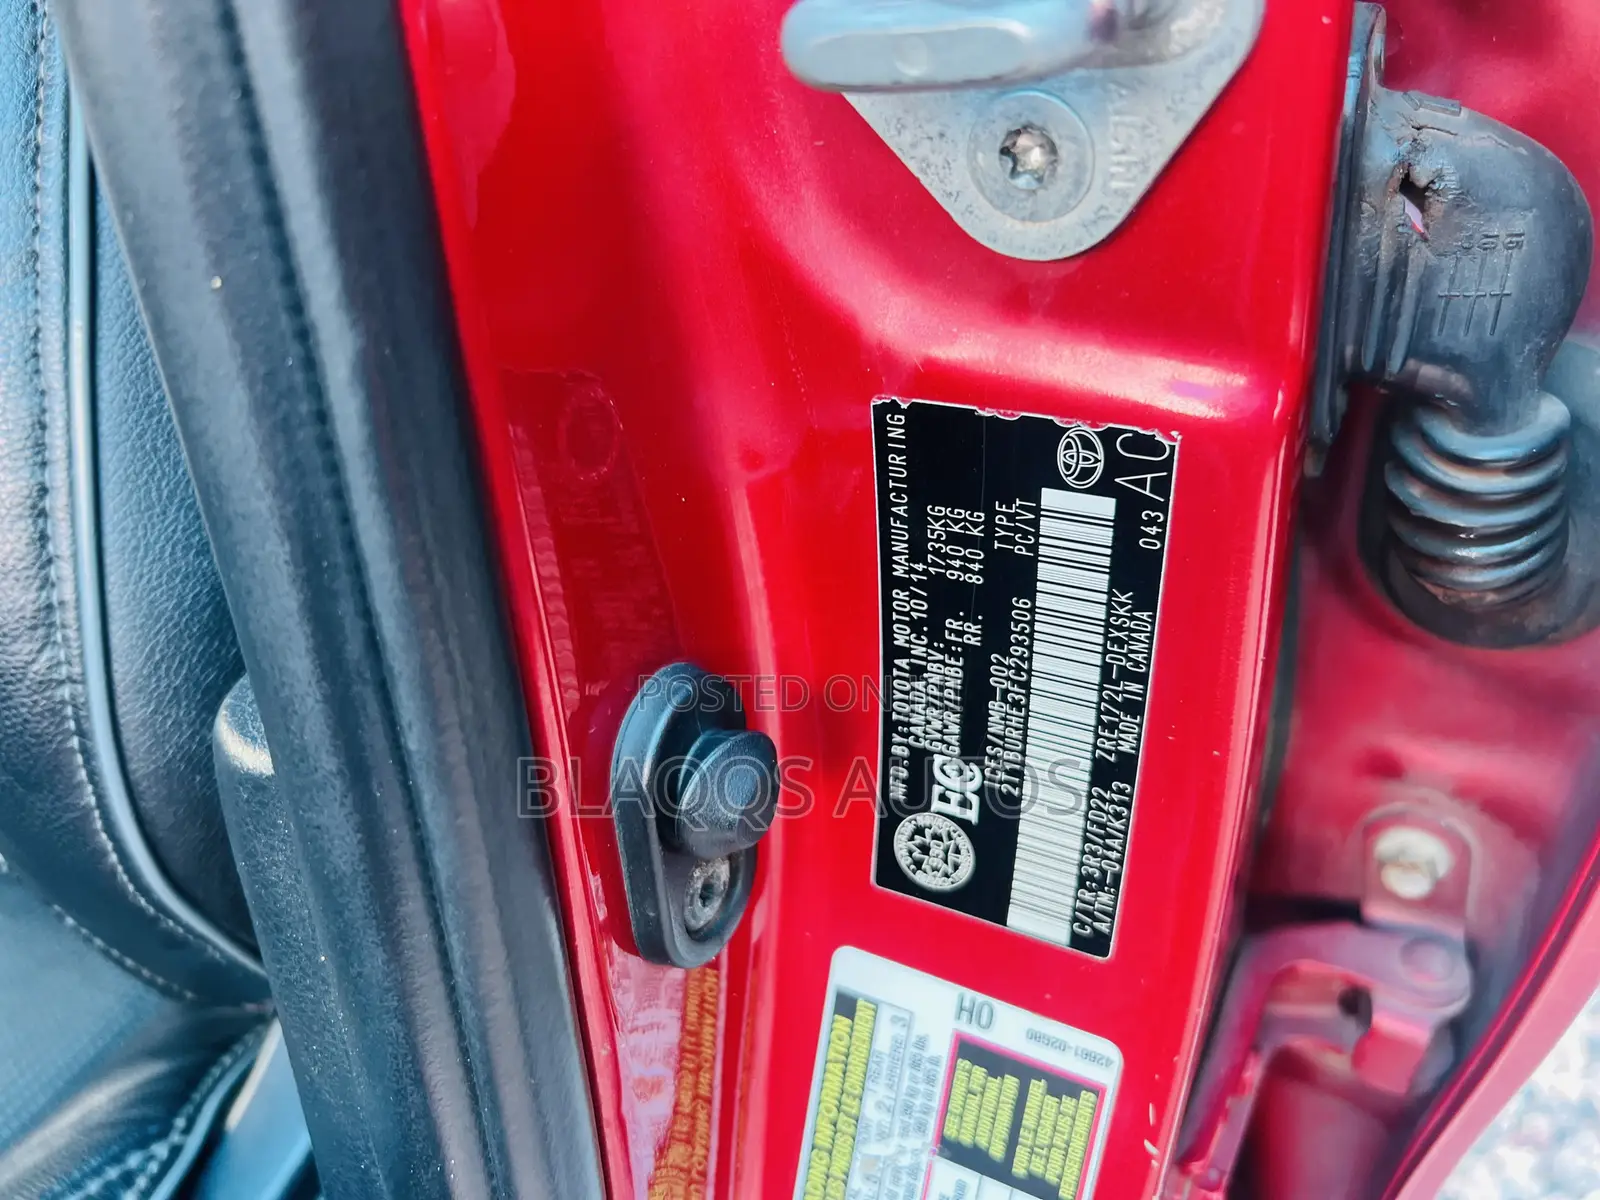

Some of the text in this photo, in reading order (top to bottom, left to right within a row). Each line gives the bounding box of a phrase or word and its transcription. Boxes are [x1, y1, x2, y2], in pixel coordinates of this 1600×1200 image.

[887, 413, 910, 578] MANUFACTURING
[946, 507, 965, 532] KG
[1114, 432, 1170, 550] 043 AC
[946, 546, 965, 581] 940
[963, 511, 985, 647] RR. 840 KG
[893, 588, 910, 647] MOTOR
[925, 505, 946, 752] GVWR/PNBV: 1735KG
[984, 501, 1015, 788] ICES/NMB-002 TYPE
[1001, 498, 1036, 797] 2T1BURHE3FC293506 PC/VT
[1096, 588, 1133, 763] ZRE172L-DEXSKK
[1117, 611, 1152, 755] MADE IN CANADA
[814, 1014, 853, 1149] INFORMATION
[843, 998, 878, 1098] CHARGEMENT
[840, 1093, 862, 1118] LE
[943, 1113, 962, 1142] SEE
[958, 1065, 988, 1148] MANUAL FOR
[975, 1076, 1003, 1152] ADDITIONAL
[989, 1074, 1020, 1162] INFORMATION
[1012, 1079, 1048, 1179] VOIR LE MANUEL
[1045, 1095, 1079, 1186] POUR PLUS DE
